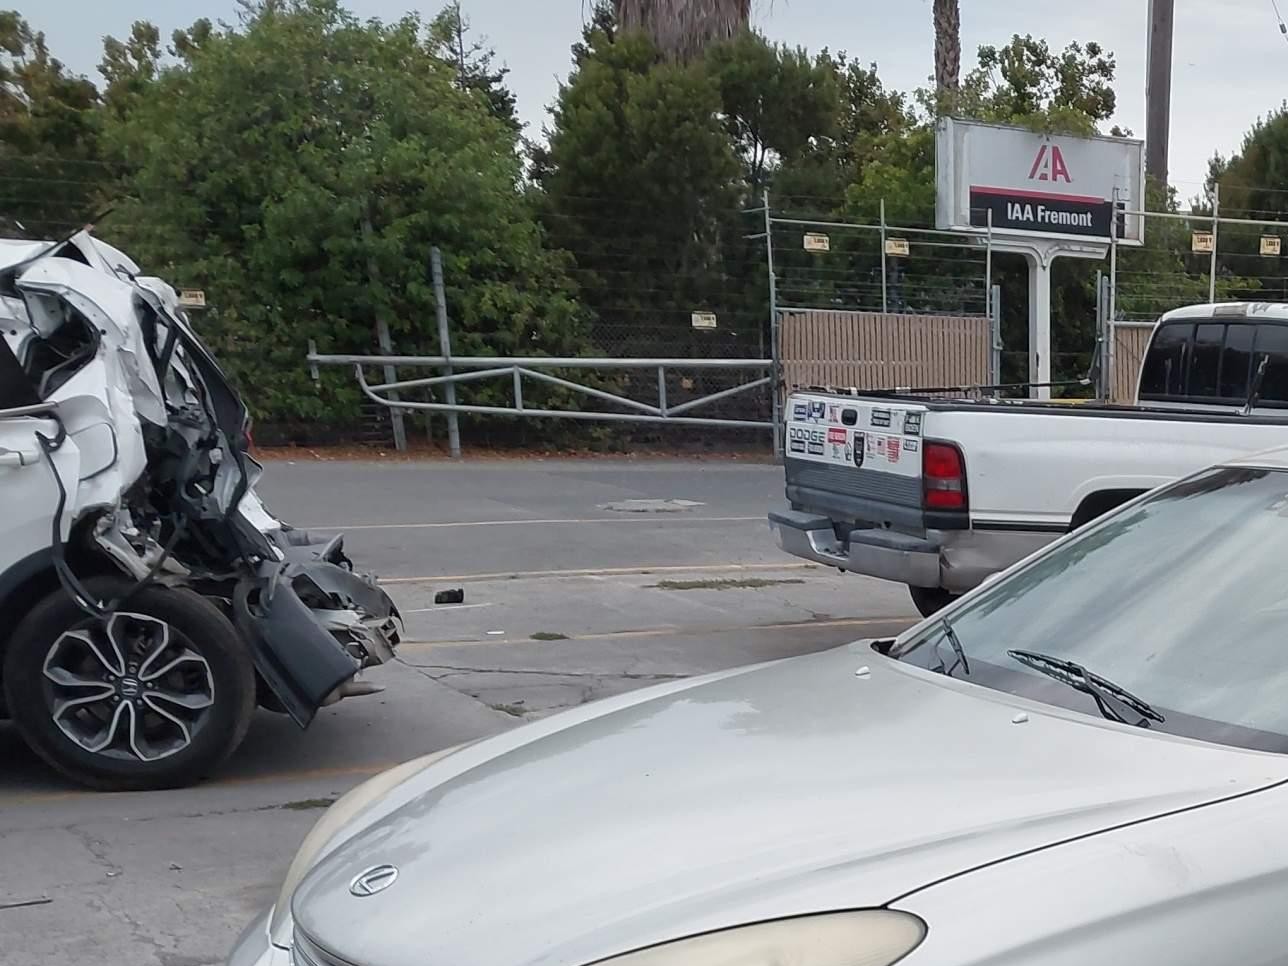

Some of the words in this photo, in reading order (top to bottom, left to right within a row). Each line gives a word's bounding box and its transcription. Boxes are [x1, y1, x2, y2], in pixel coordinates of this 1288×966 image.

[1007, 202, 1034, 222] IAA
[1037, 205, 1093, 227] Fremont
[790, 427, 826, 443] DODGE
